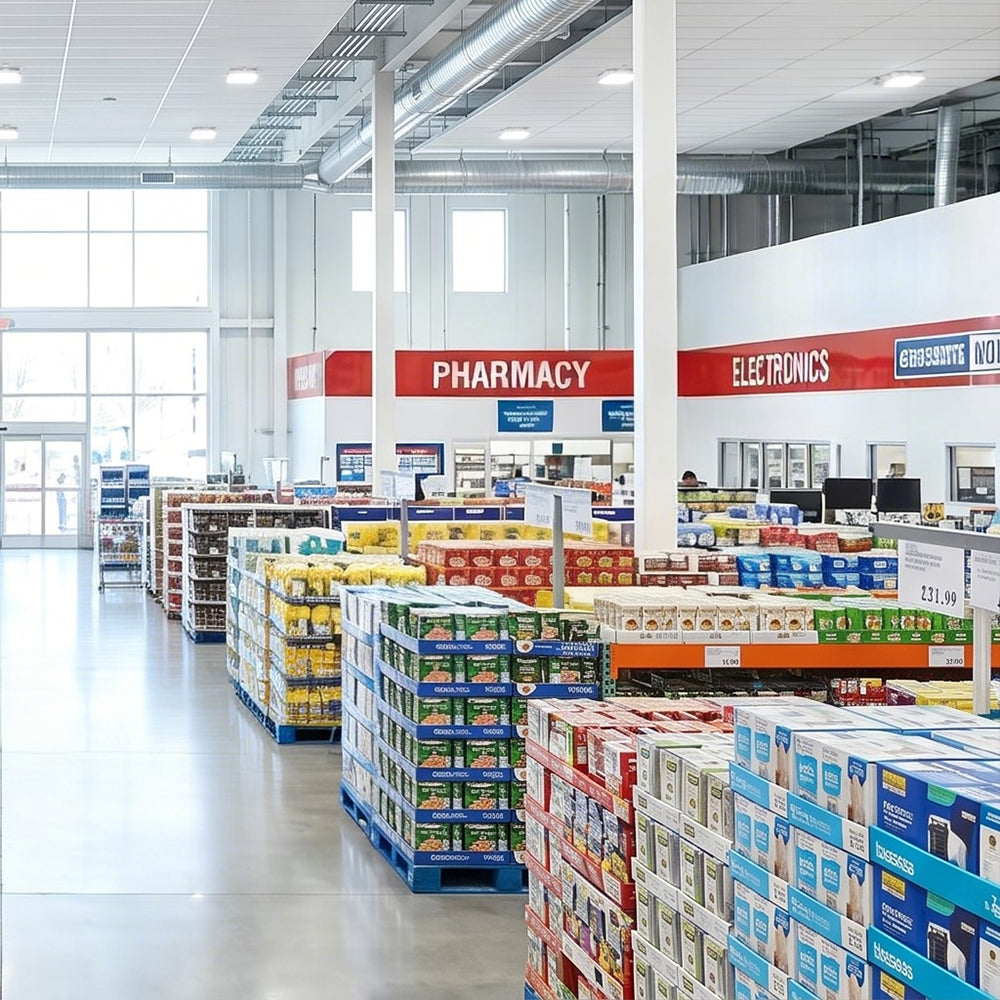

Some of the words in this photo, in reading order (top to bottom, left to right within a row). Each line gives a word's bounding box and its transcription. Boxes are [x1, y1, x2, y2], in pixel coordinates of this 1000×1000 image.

[432, 360, 591, 389] PHARMACY
[732, 348, 830, 387] ELECTRONICS
[921, 585, 957, 607] 231.99
